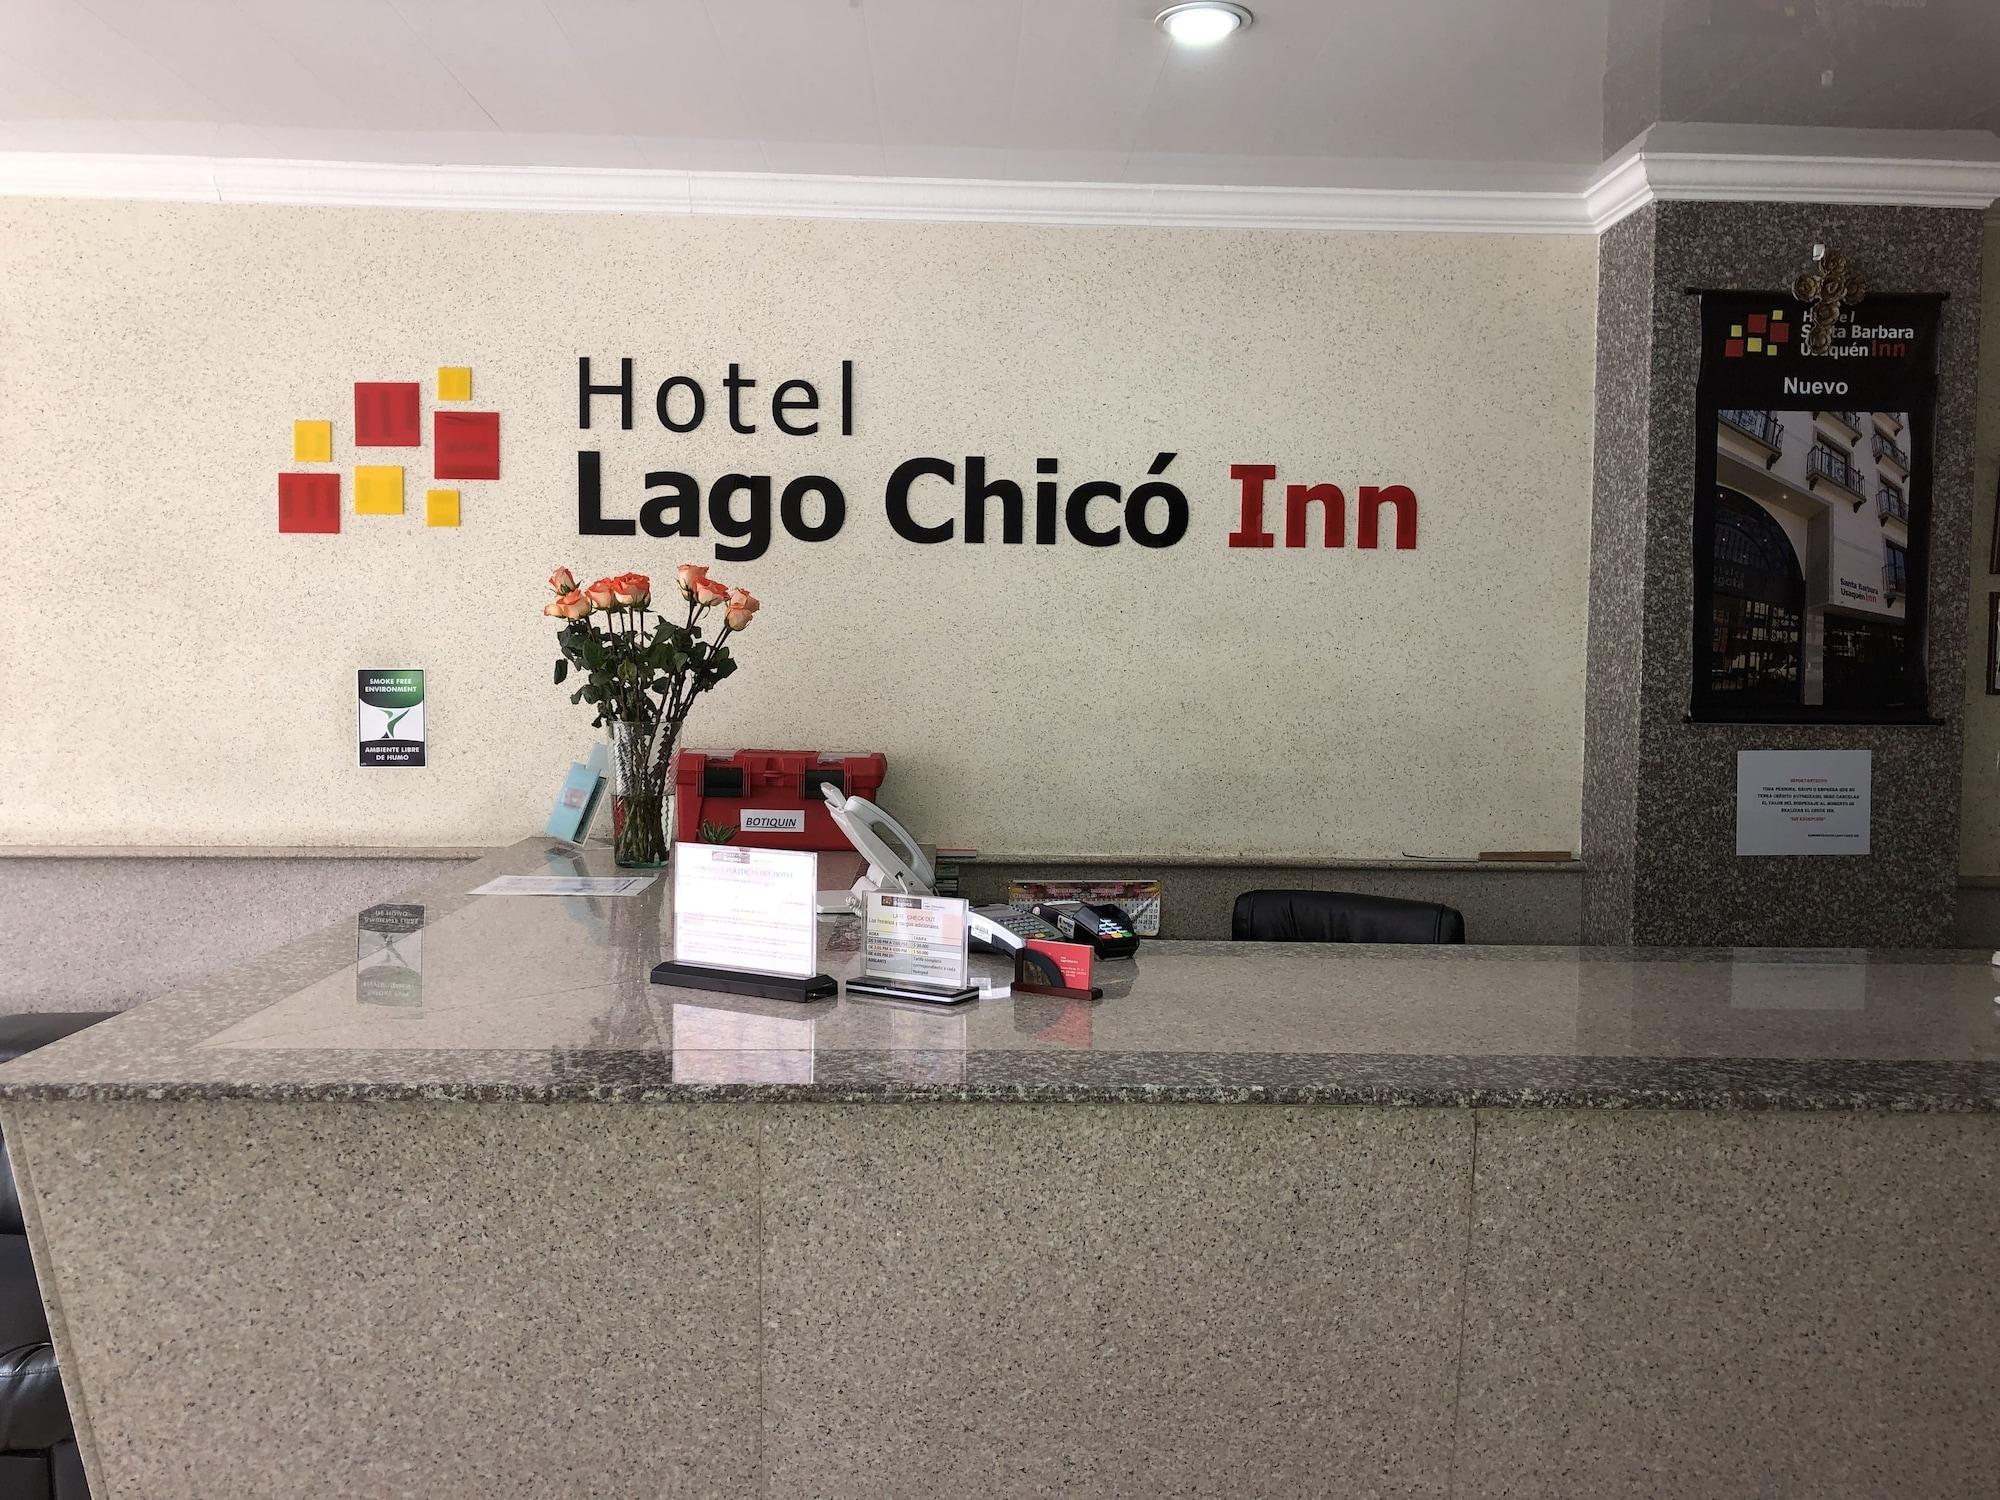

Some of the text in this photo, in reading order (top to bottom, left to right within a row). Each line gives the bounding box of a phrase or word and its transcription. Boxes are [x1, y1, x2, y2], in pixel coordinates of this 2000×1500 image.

[1802, 310, 1856, 323] Hel
[1800, 324, 1914, 340] Sta Barbara
[1800, 340, 1906, 360] Uquén Inn
[1783, 376, 1849, 395] Nuevo
[579, 356, 852, 436] Hotel
[578, 450, 1418, 562] Lago Chicó Inn
[746, 817, 797, 828] BOTIQUIN
